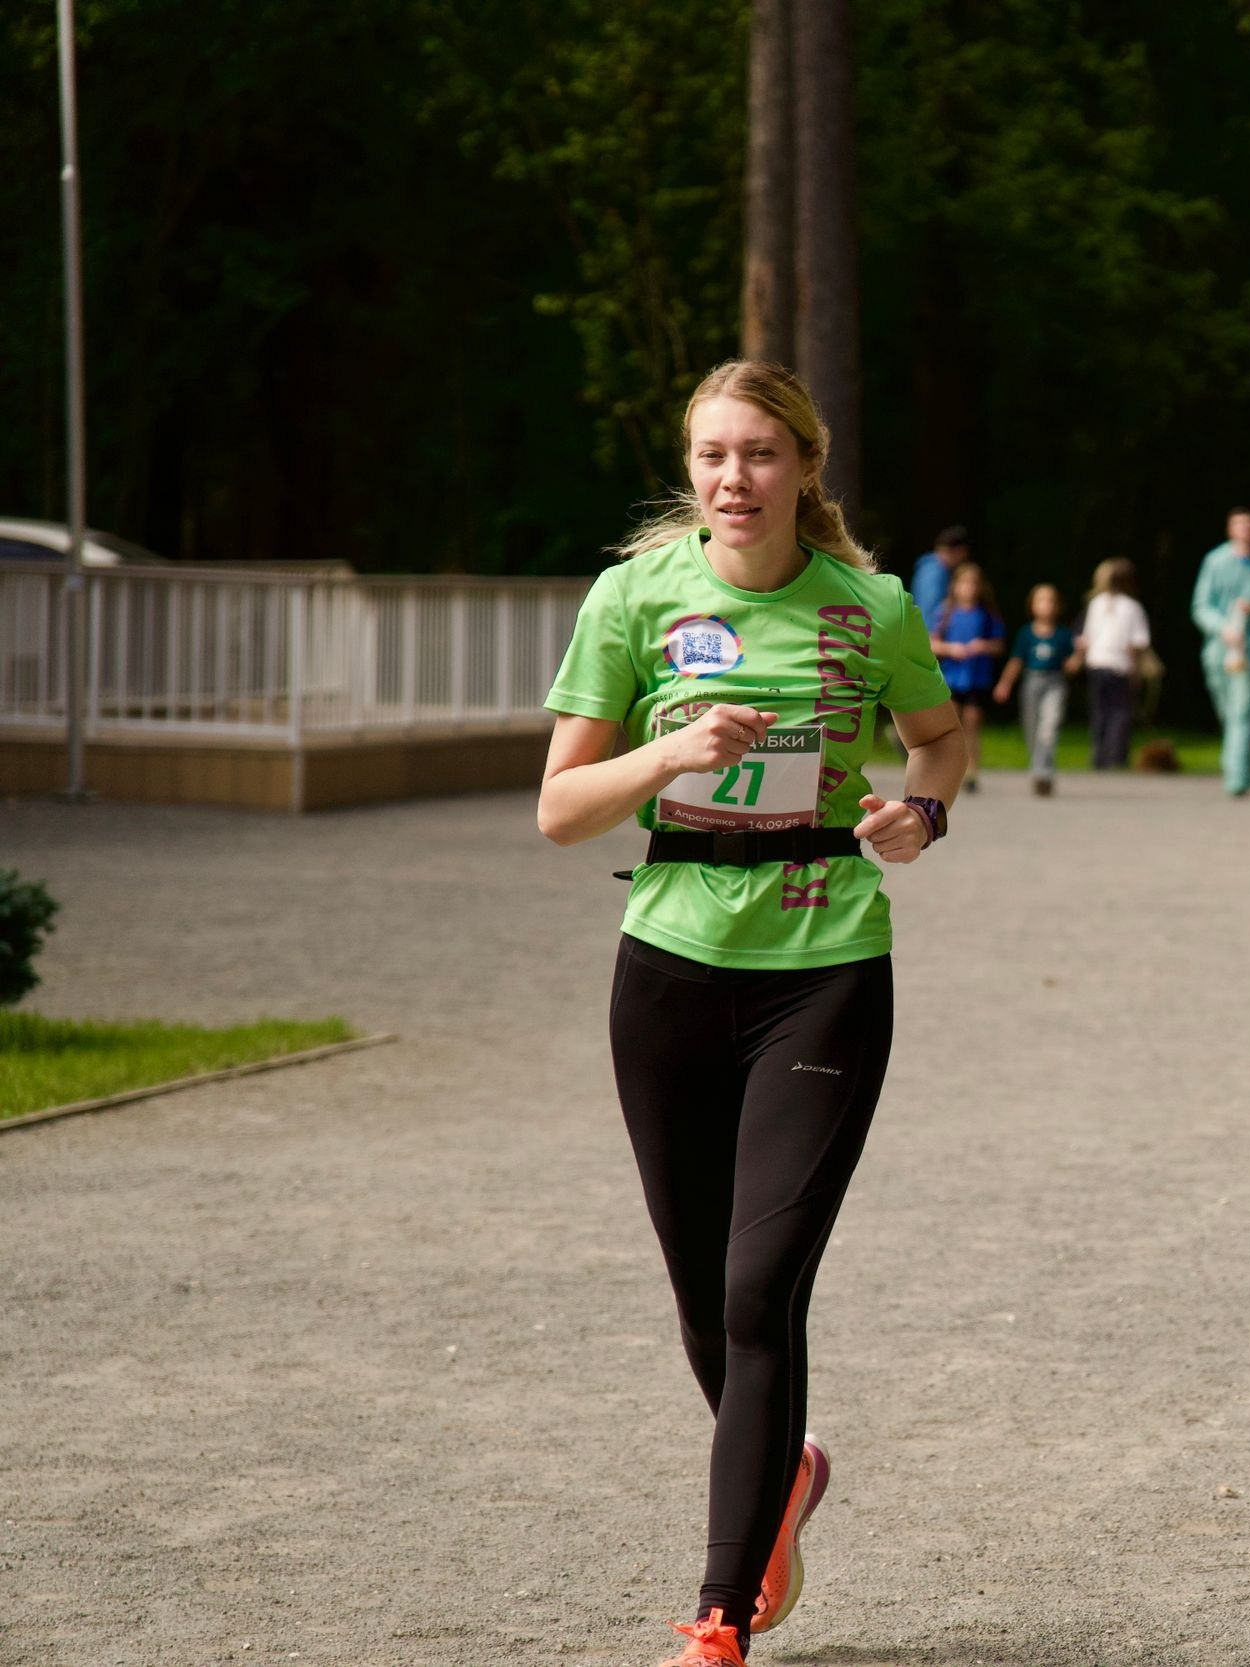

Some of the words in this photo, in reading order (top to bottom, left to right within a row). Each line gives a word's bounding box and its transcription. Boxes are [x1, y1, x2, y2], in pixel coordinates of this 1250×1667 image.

[712, 761, 765, 806] 27
[674, 809, 736, 827] Апрелевка
[747, 818, 800, 831] 14.09.25
